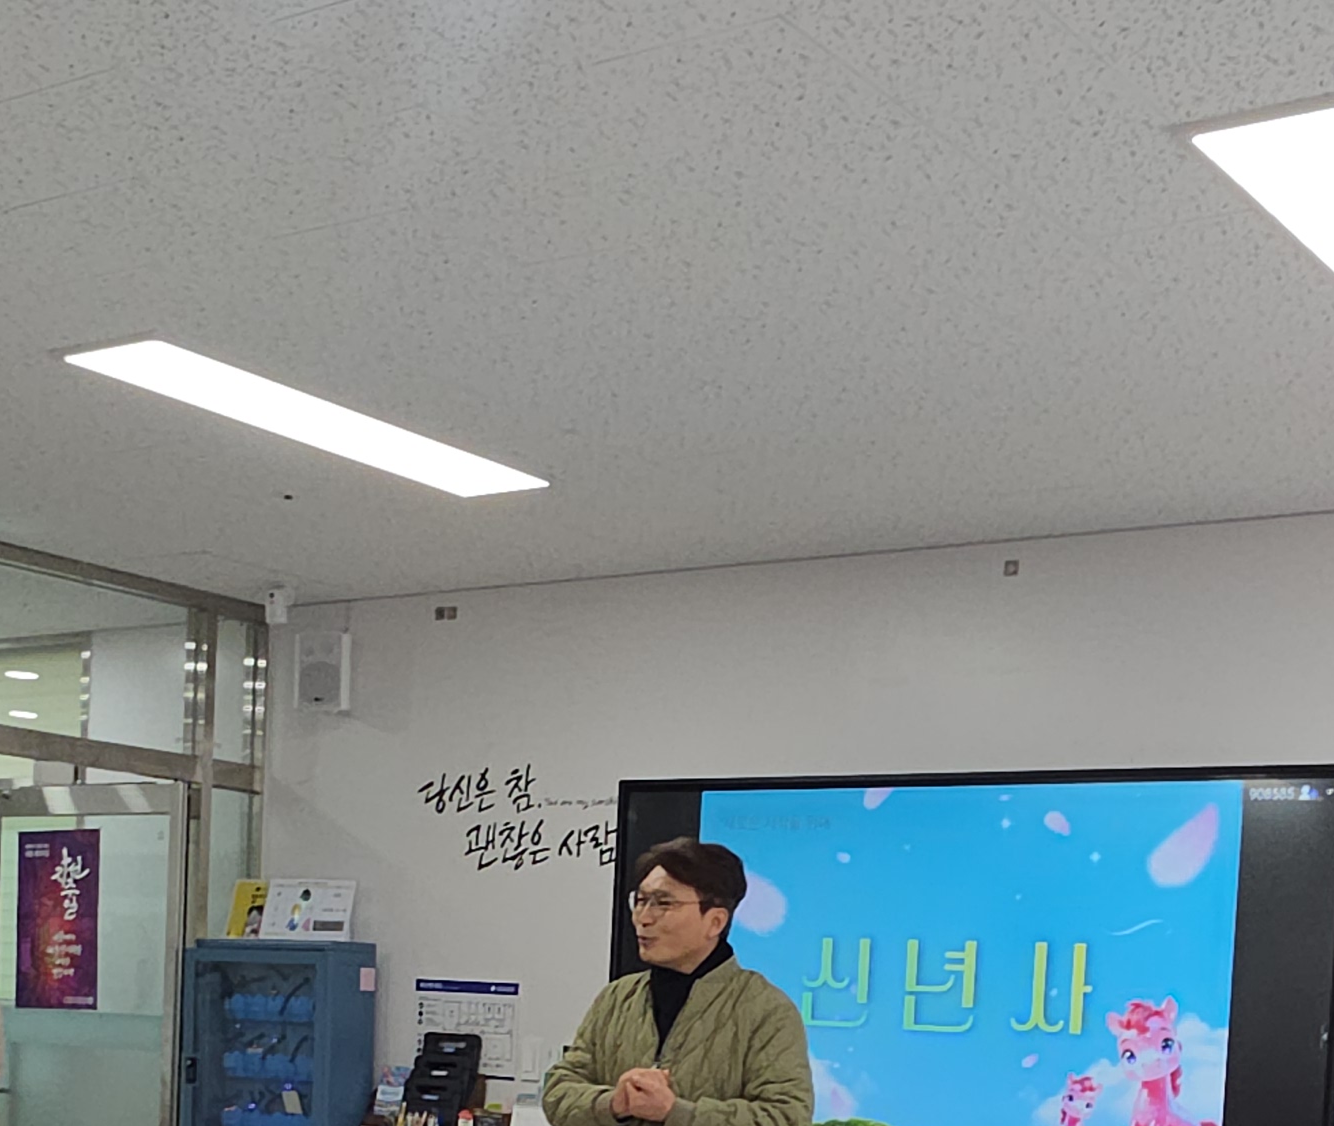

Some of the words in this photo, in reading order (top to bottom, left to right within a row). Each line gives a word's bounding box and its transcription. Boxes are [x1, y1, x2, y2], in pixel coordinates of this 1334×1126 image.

[418, 767, 496, 814] 당신은
[465, 819, 551, 871] 괜찮은
[557, 820, 618, 867] 사람
[802, 936, 1093, 1035] 신년사
